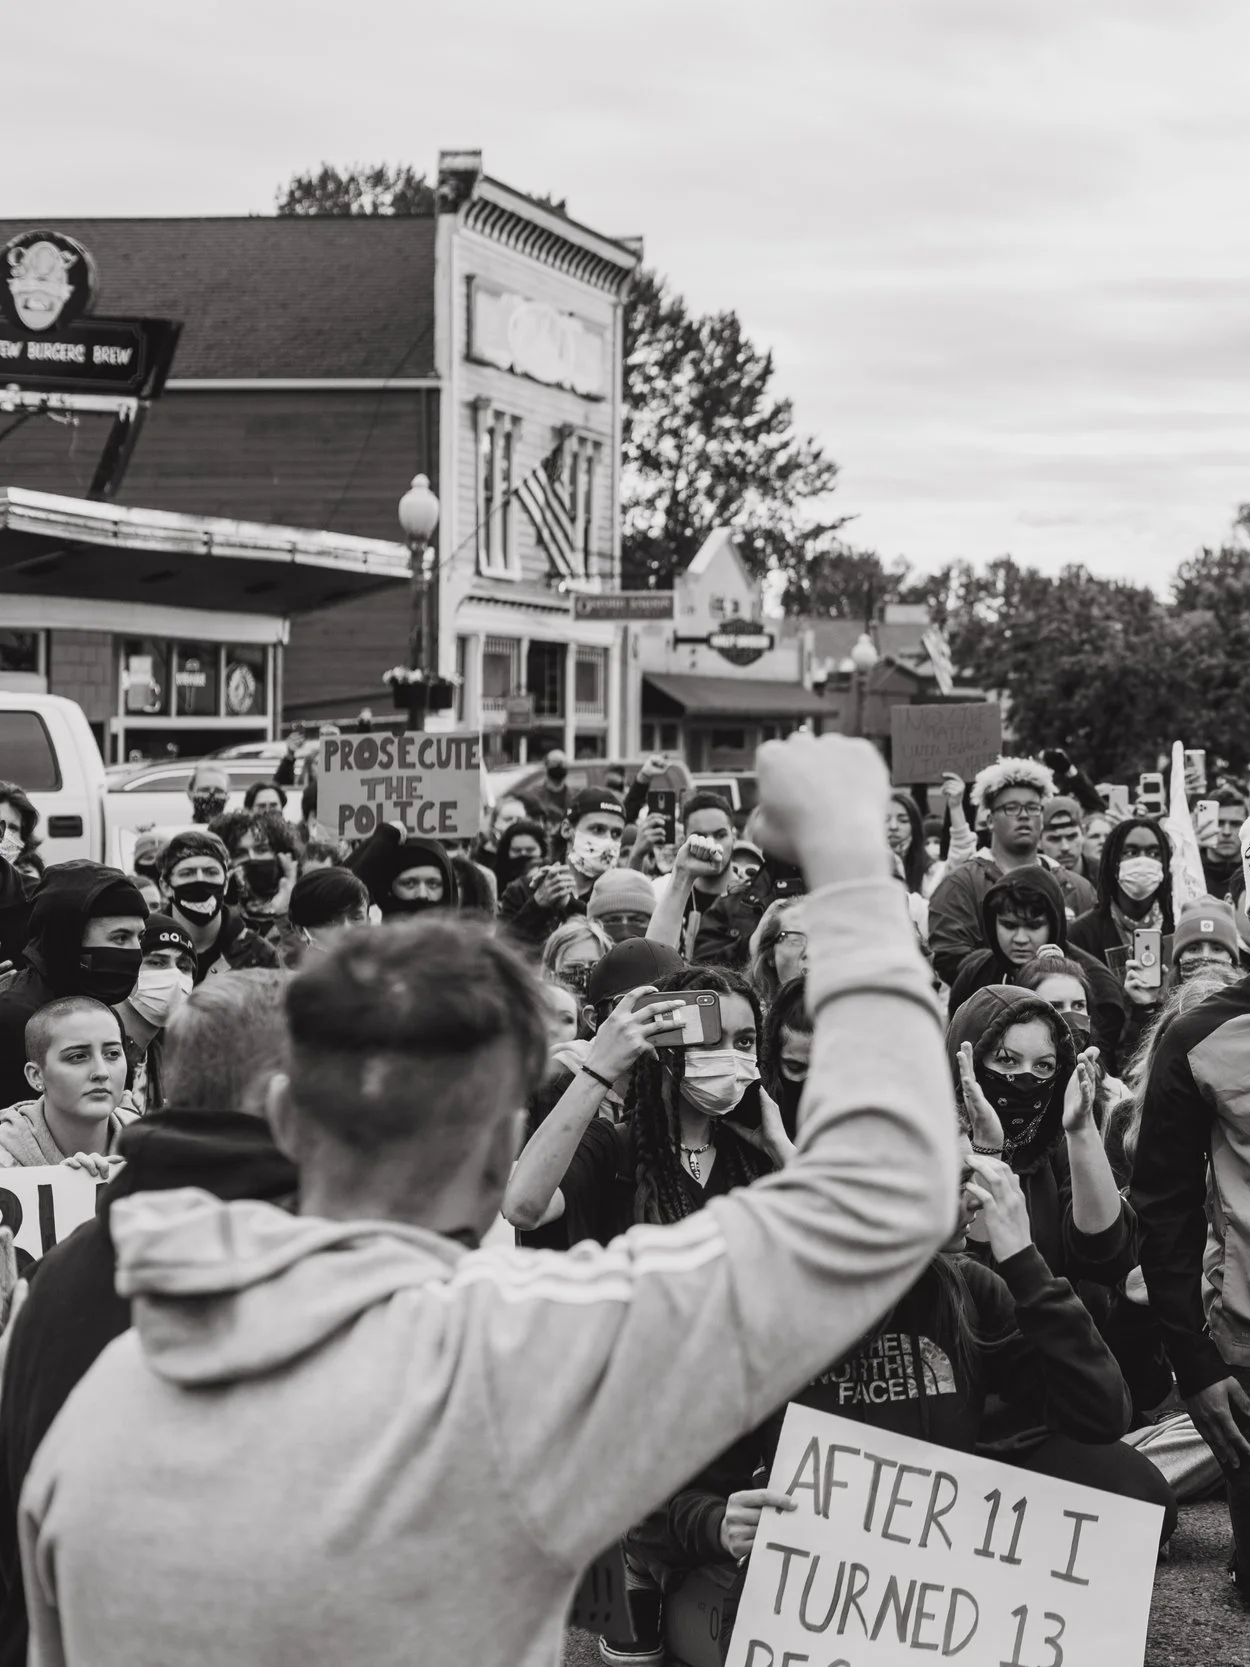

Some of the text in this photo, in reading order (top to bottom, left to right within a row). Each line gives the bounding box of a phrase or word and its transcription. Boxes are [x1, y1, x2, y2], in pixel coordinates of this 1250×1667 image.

[0, 340, 133, 365] EW BURGERS BREW
[325, 737, 480, 772] PROSECUTE
[360, 775, 423, 801] THE
[862, 1333, 900, 1358] HE
[809, 1355, 904, 1386] ORTH
[839, 1378, 906, 1405] FACE
[776, 1436, 1099, 1587] AFTER 11 I
[766, 1541, 980, 1657] TURNED
[999, 1604, 1066, 1667] 13
